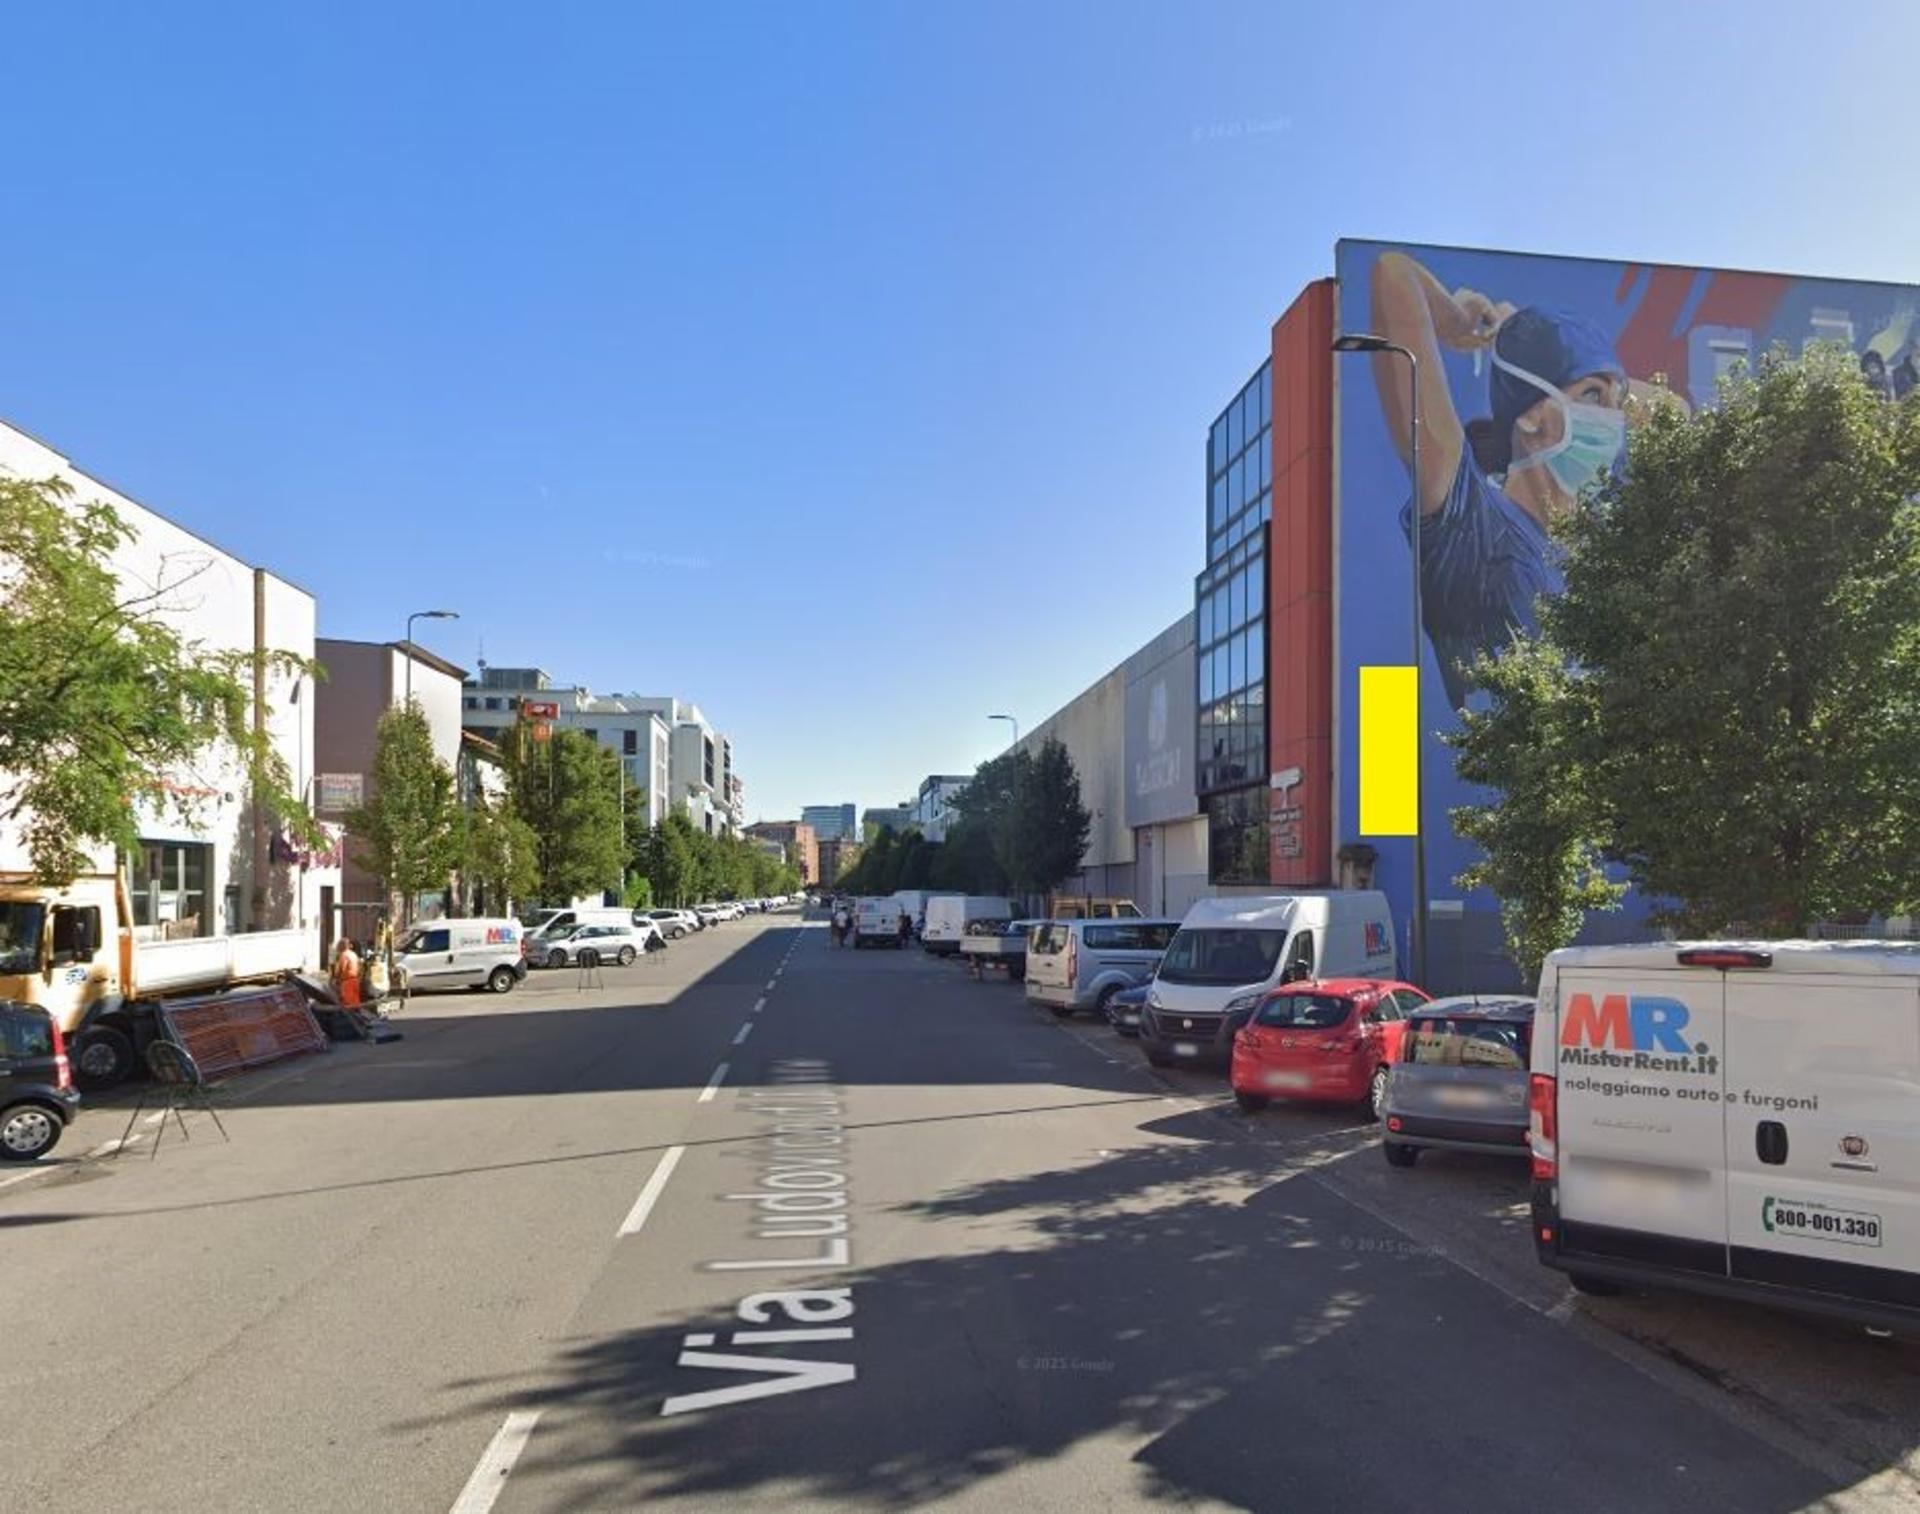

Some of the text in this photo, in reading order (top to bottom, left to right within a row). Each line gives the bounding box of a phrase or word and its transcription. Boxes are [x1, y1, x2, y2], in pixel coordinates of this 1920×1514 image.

[1561, 993, 1709, 1054] MR.
[1560, 1047, 1719, 1075] MisterRent.it
[1565, 1077, 1818, 1111] noleggiamo auto e furgoni
[1775, 1209, 1878, 1238] 800-001.330
